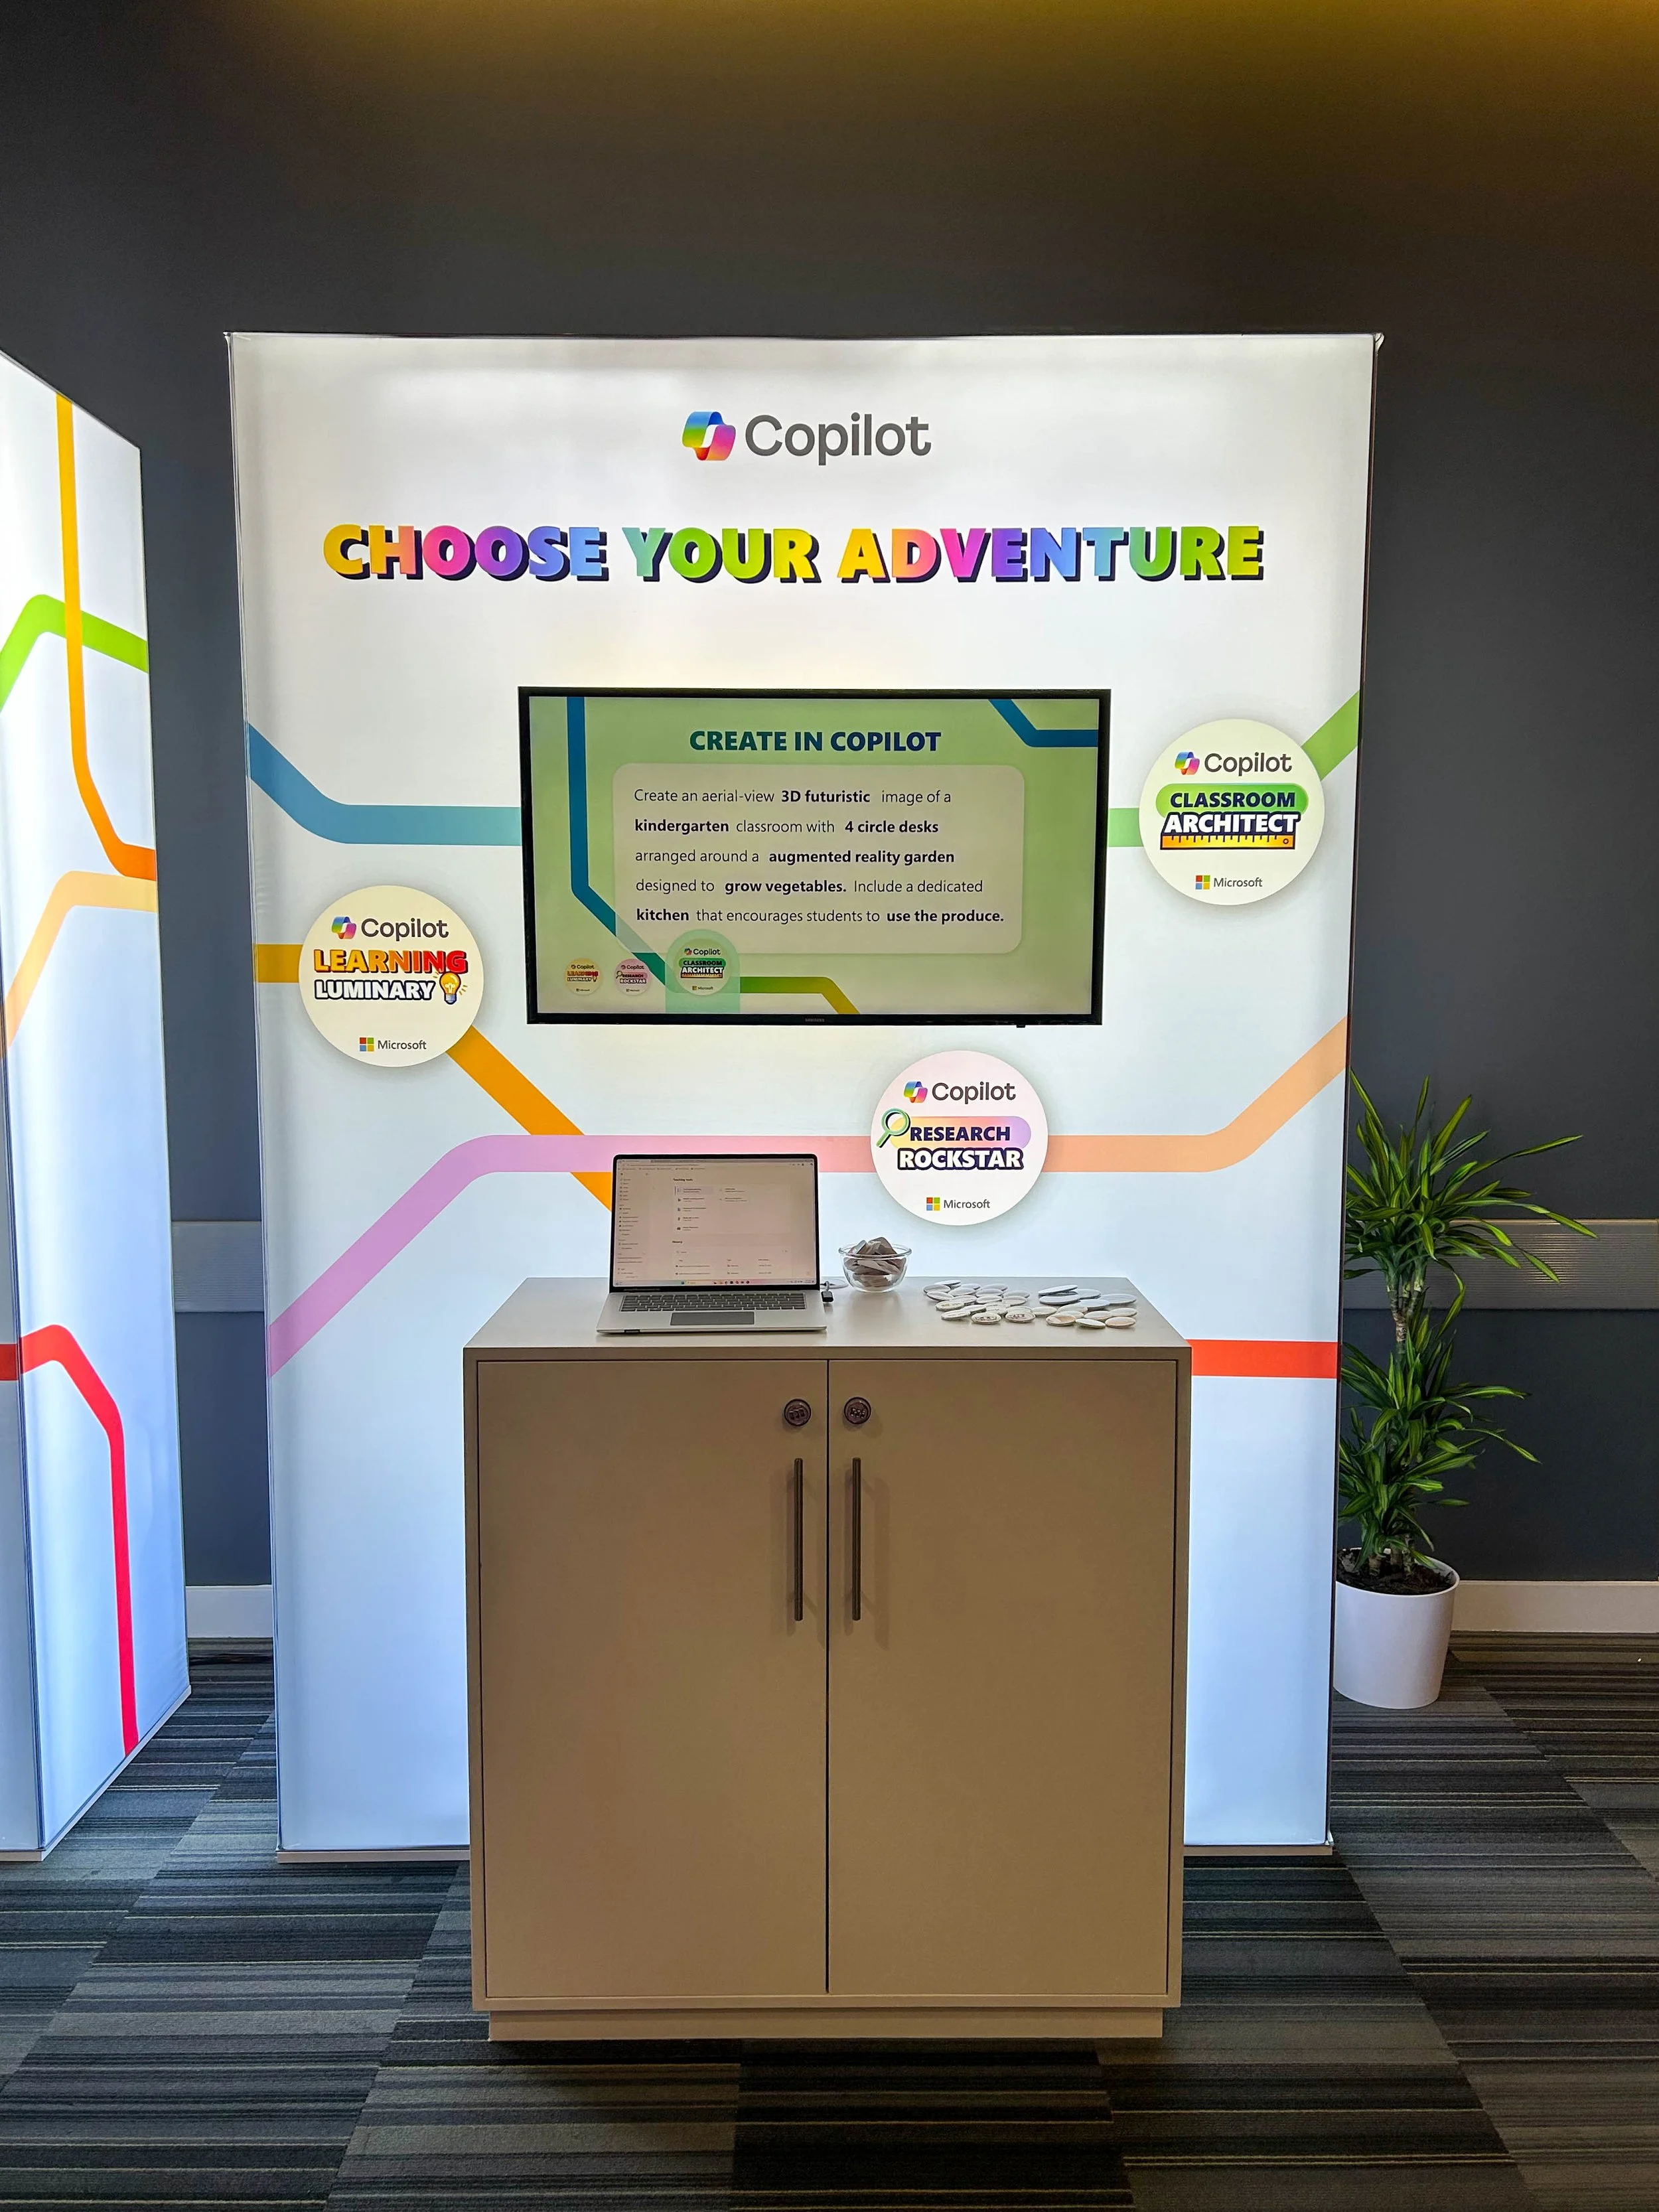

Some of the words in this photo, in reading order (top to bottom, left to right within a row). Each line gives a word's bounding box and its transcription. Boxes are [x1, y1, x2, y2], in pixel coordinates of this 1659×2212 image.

[745, 411, 932, 466] Copilot
[323, 523, 609, 582] CHOOSE
[622, 526, 822, 583] YOUR
[837, 526, 1264, 583] ADVENTURE
[689, 730, 787, 751] CREATE
[794, 731, 823, 751] IN
[830, 731, 942, 752] COPILOT
[1204, 752, 1293, 776] Copilot
[634, 788, 678, 802] Create
[682, 792, 698, 802] an
[701, 789, 775, 802] aerial-view
[781, 790, 801, 802] 3D
[804, 789, 871, 803] futuristic
[881, 790, 923, 806] image
[926, 789, 941, 803] of
[944, 793, 951, 803] a
[1170, 792, 1295, 808] CLASSROOM
[634, 818, 729, 836] kindergarten
[736, 819, 802, 833] classroom
[806, 820, 835, 833] with
[845, 820, 854, 833] 4
[857, 820, 895, 833] circle
[899, 820, 939, 833] desks
[1163, 812, 1301, 834] ARCHITECT
[635, 849, 696, 865] arranged
[699, 849, 748, 862] around
[751, 853, 759, 862] a
[768, 849, 851, 866] augmented
[855, 849, 901, 866] reality
[904, 849, 954, 866] garden
[636, 878, 696, 895] designed
[700, 880, 715, 892] to
[725, 883, 762, 895] grow
[765, 879, 847, 895] vegetables.
[854, 879, 902, 893] Include
[906, 883, 913, 893] a
[917, 879, 983, 893] dedicated
[1213, 877, 1263, 887] Microsoft
[636, 908, 689, 921] kitchen
[695, 909, 723, 921] that
[726, 912, 803, 925] encourages
[806, 909, 863, 922] students
[865, 911, 880, 922] to
[887, 913, 911, 922] use
[914, 909, 938, 922] the
[941, 909, 1004, 925] produce.
[361, 917, 449, 941] Copilot
[314, 949, 469, 974] LEARNING
[315, 979, 436, 1000] LUMINARY
[378, 1039, 427, 1050] Microsoft
[932, 1081, 1016, 1104] Copilot
[910, 1126, 1011, 1141] RESEARCH
[897, 1147, 1024, 1170] ROCKSTAR
[943, 1199, 991, 1209] Microsoft
